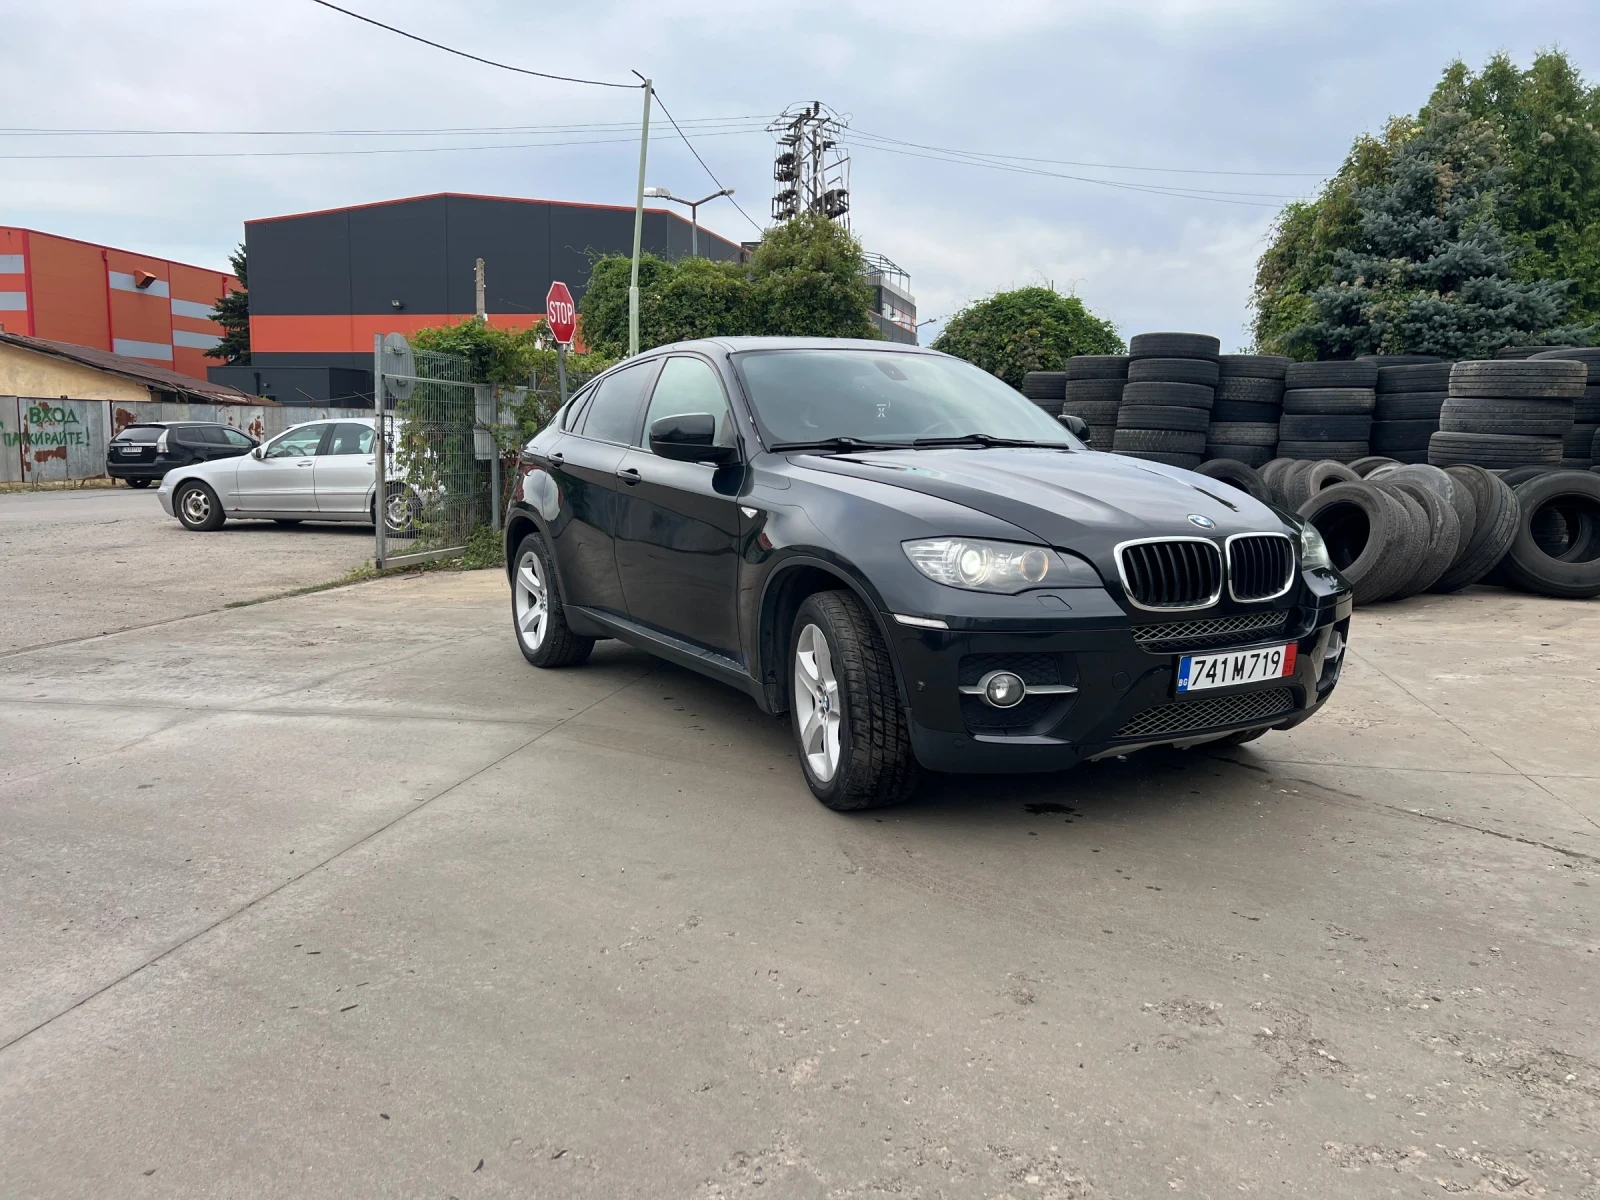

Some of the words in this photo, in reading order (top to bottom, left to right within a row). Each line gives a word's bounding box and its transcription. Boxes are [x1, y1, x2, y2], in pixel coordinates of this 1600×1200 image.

[550, 301, 572, 324] STOP
[29, 407, 79, 424] ВХОД
[1192, 651, 1280, 686] 741M719
[1178, 678, 1188, 686] BG
